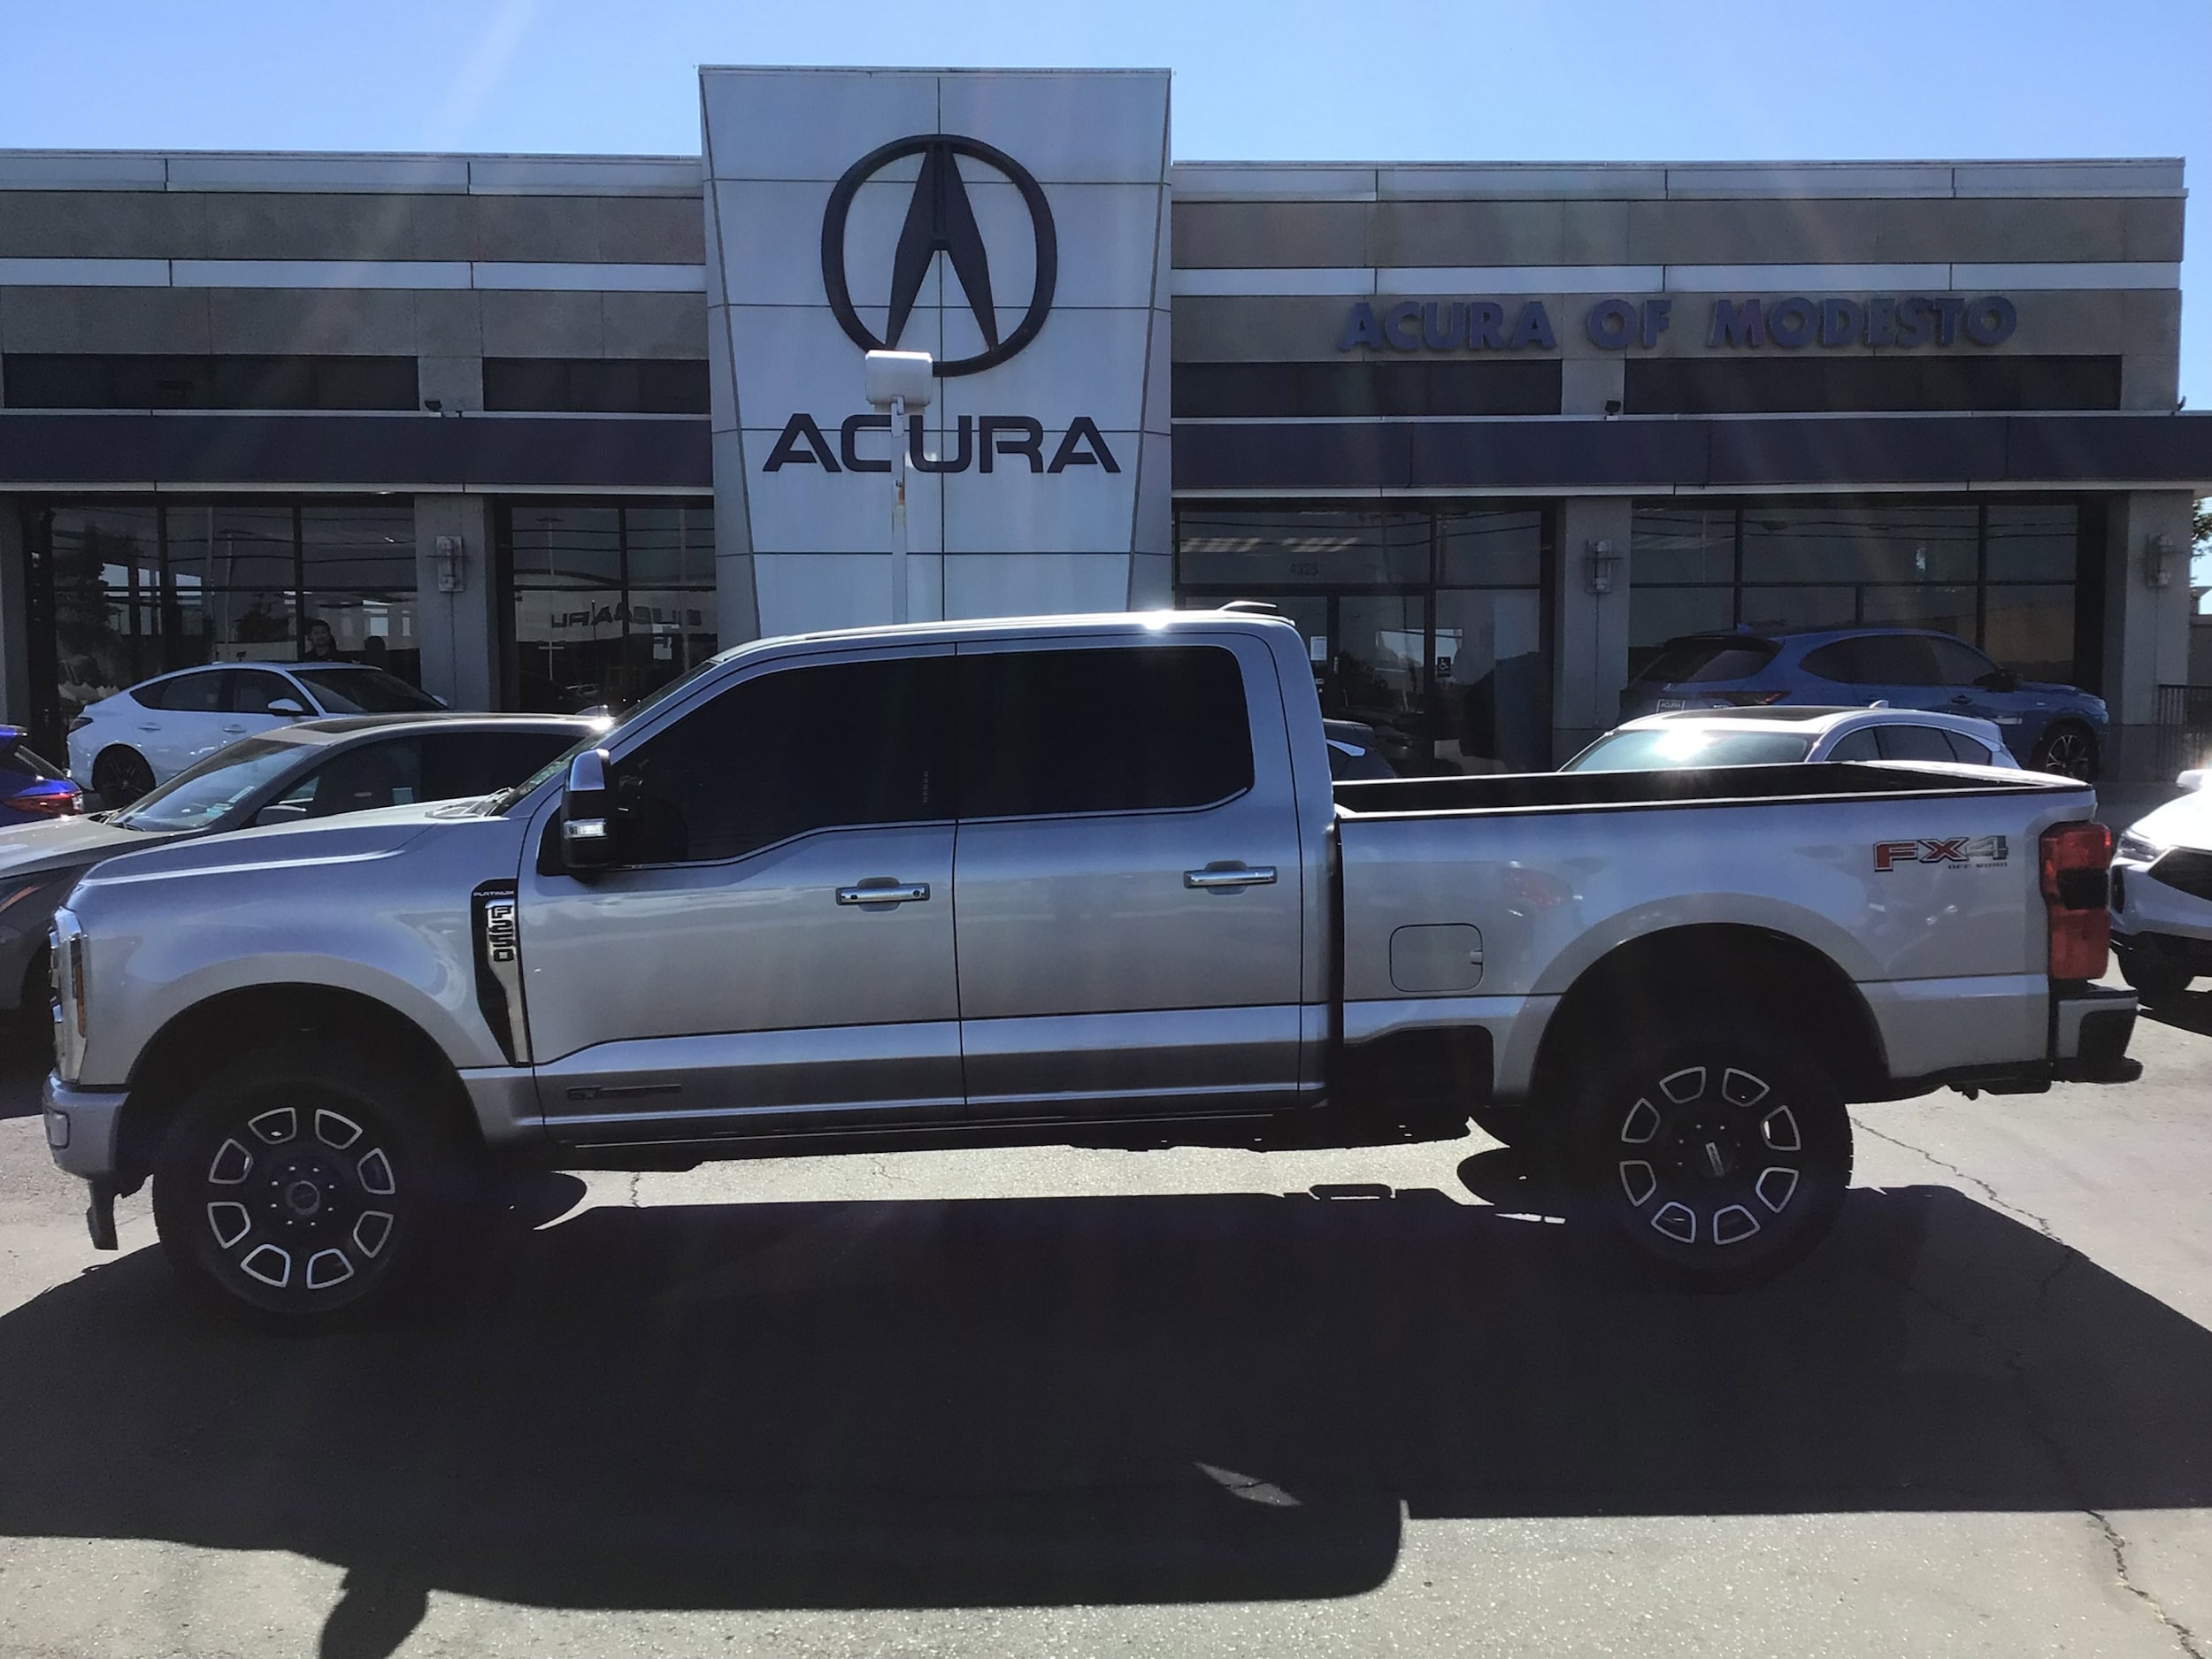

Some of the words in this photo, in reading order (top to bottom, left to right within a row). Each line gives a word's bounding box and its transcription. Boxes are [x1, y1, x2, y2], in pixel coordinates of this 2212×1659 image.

[1340, 300, 1559, 351] ACURA
[1587, 298, 1672, 349] OF
[1708, 295, 2018, 348] MODESTO
[762, 413, 1122, 473] ACURA
[1873, 834, 2009, 872] FX4
